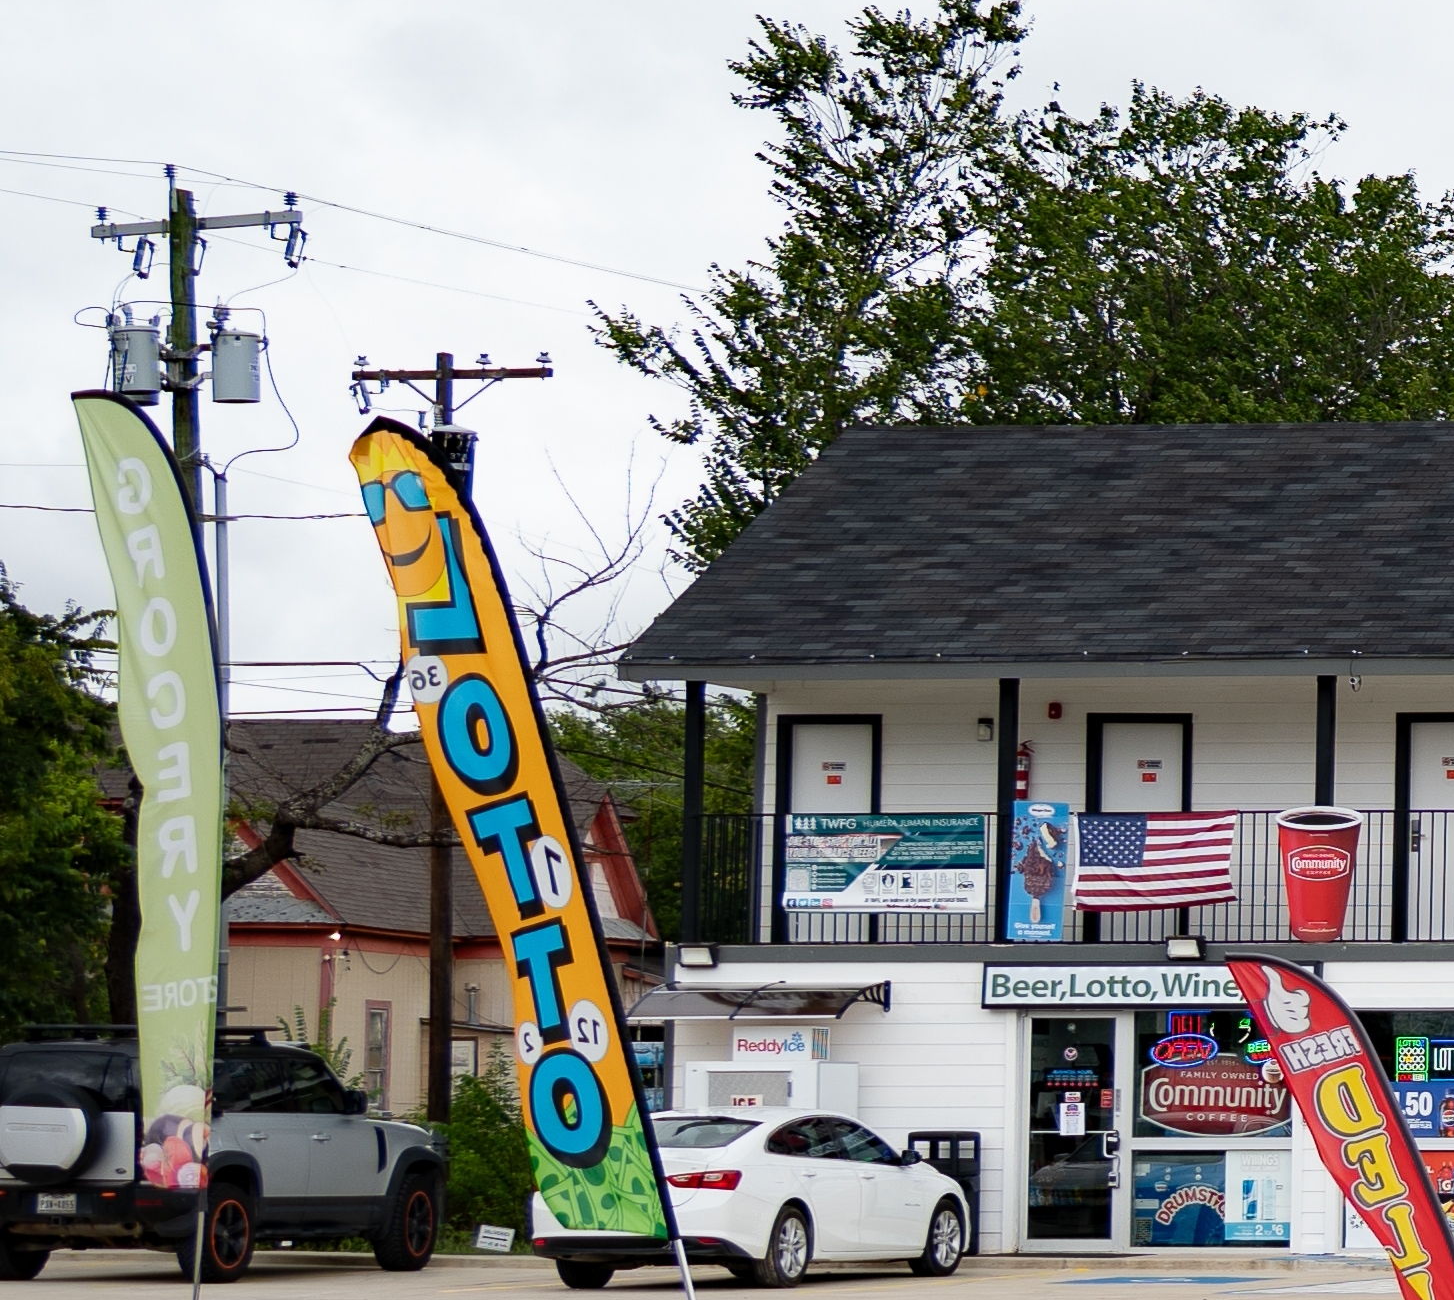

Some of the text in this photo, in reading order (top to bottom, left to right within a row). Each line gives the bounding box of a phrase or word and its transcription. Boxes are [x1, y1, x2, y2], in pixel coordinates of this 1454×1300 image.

[821, 818, 856, 829] TWFG
[933, 817, 979, 826] INSURANCE
[1292, 857, 1346, 871] Community
[1154, 1042, 1213, 1060] OPEN
[1180, 1071, 1259, 1080] FAMILY OWNED
[1150, 1077, 1286, 1114] Community
[1186, 1113, 1248, 1122] COFFEE
[1442, 1180, 1451, 1190] G
[1255, 1224, 1264, 1235] 2
